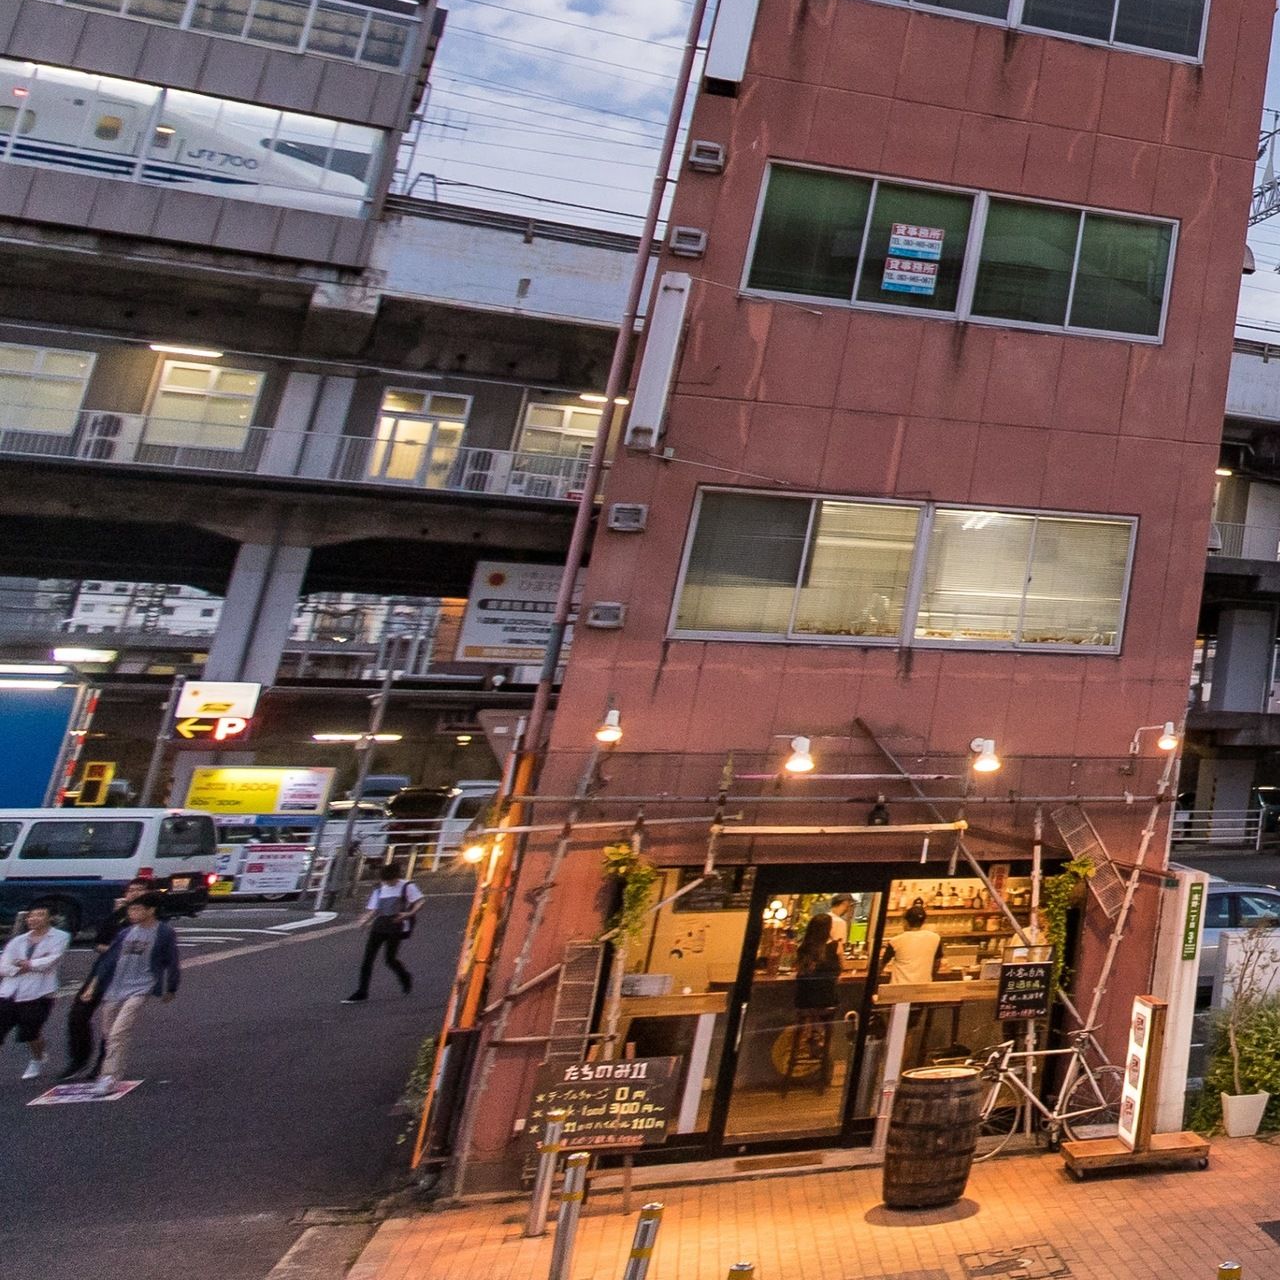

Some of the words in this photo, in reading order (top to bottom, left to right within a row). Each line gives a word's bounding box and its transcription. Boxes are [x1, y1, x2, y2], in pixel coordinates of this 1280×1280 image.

[215, 717, 247, 741] P
[563, 1062, 649, 1081] たちのみ11
